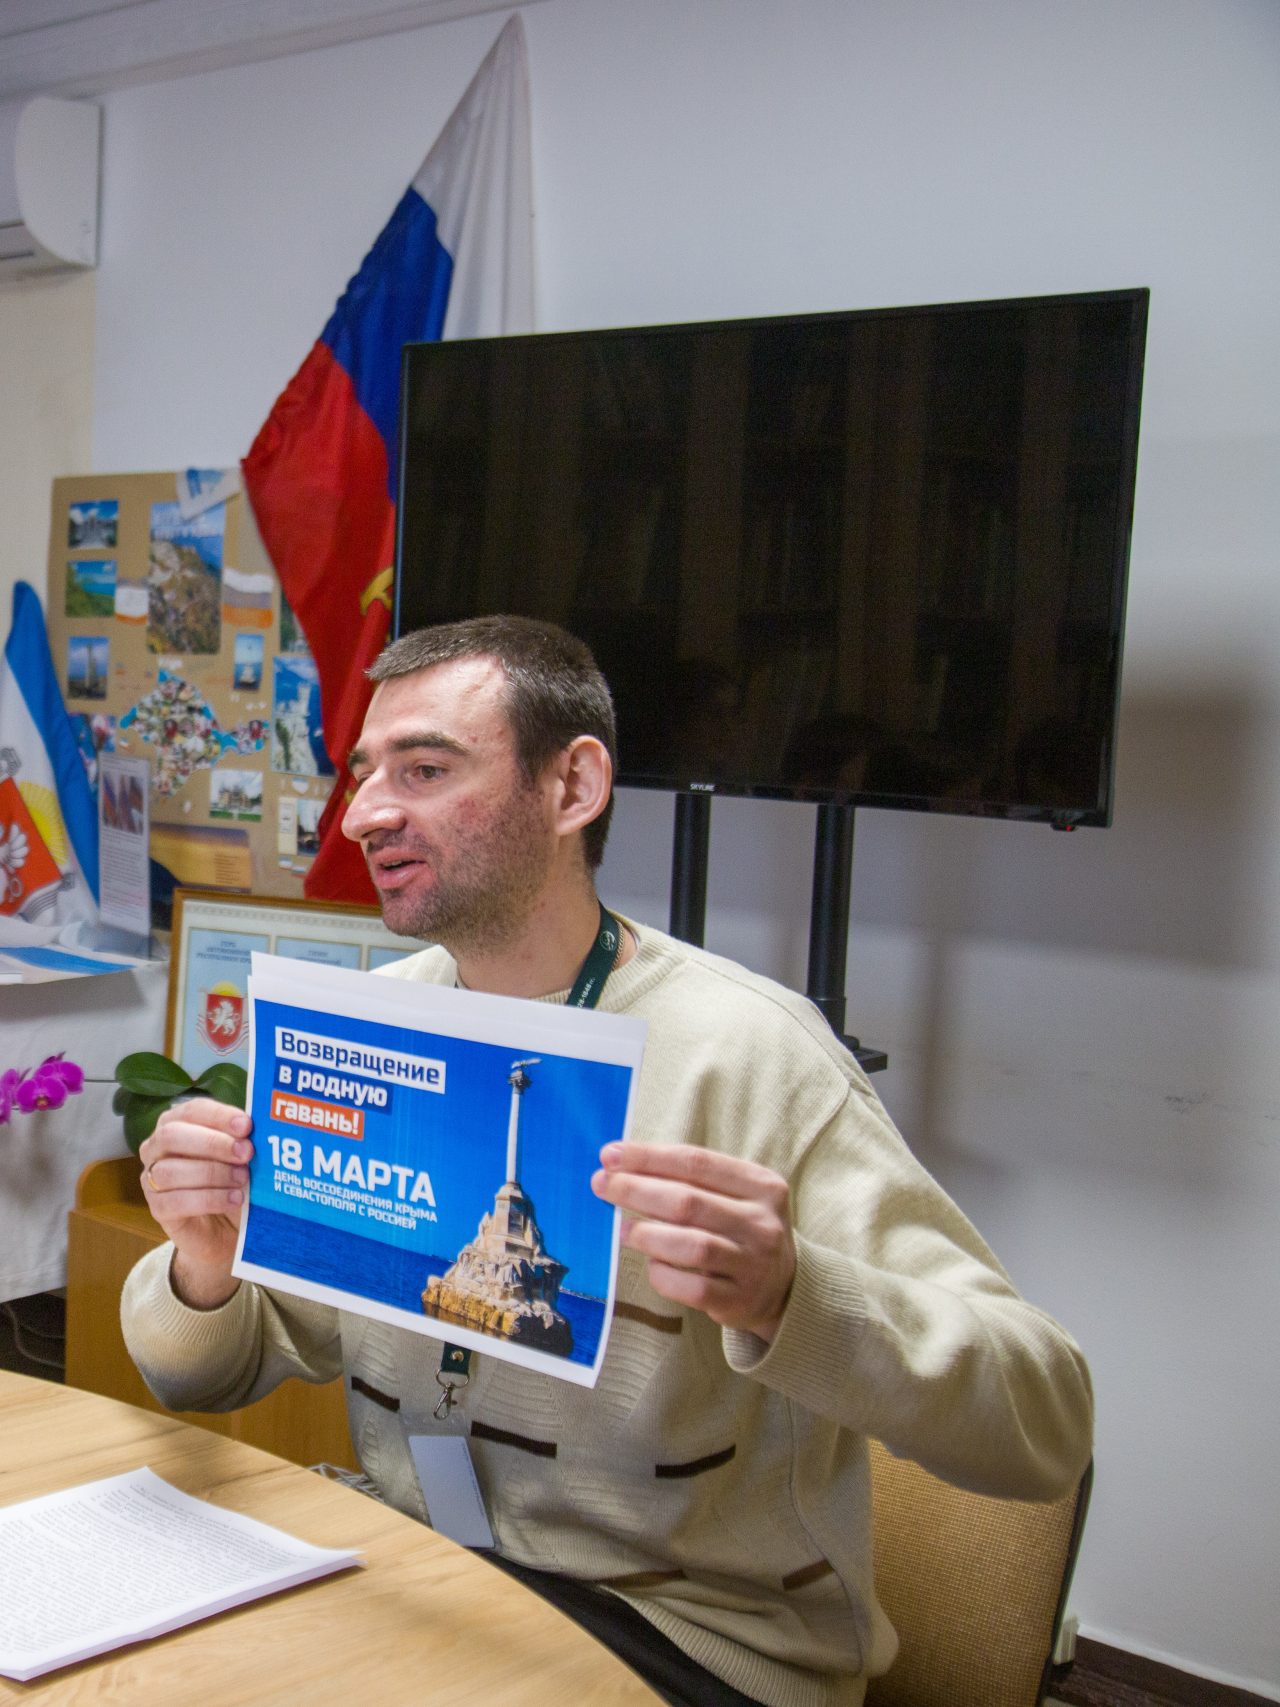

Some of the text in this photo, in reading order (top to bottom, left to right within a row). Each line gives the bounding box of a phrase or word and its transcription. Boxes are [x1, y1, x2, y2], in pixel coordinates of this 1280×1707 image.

[281, 1031, 440, 1085] Возвращение
[279, 1064, 388, 1107] в родную
[275, 1098, 360, 1135] гавань!
[268, 1135, 437, 1208] 18 МАРТА
[274, 1169, 438, 1223] ДЕНЬ ВОССОЕДИНЕНИЯ КРЫМА
[273, 1181, 417, 1231] И СЕВАСТОПОЛЯ С РОССИЕЙ
